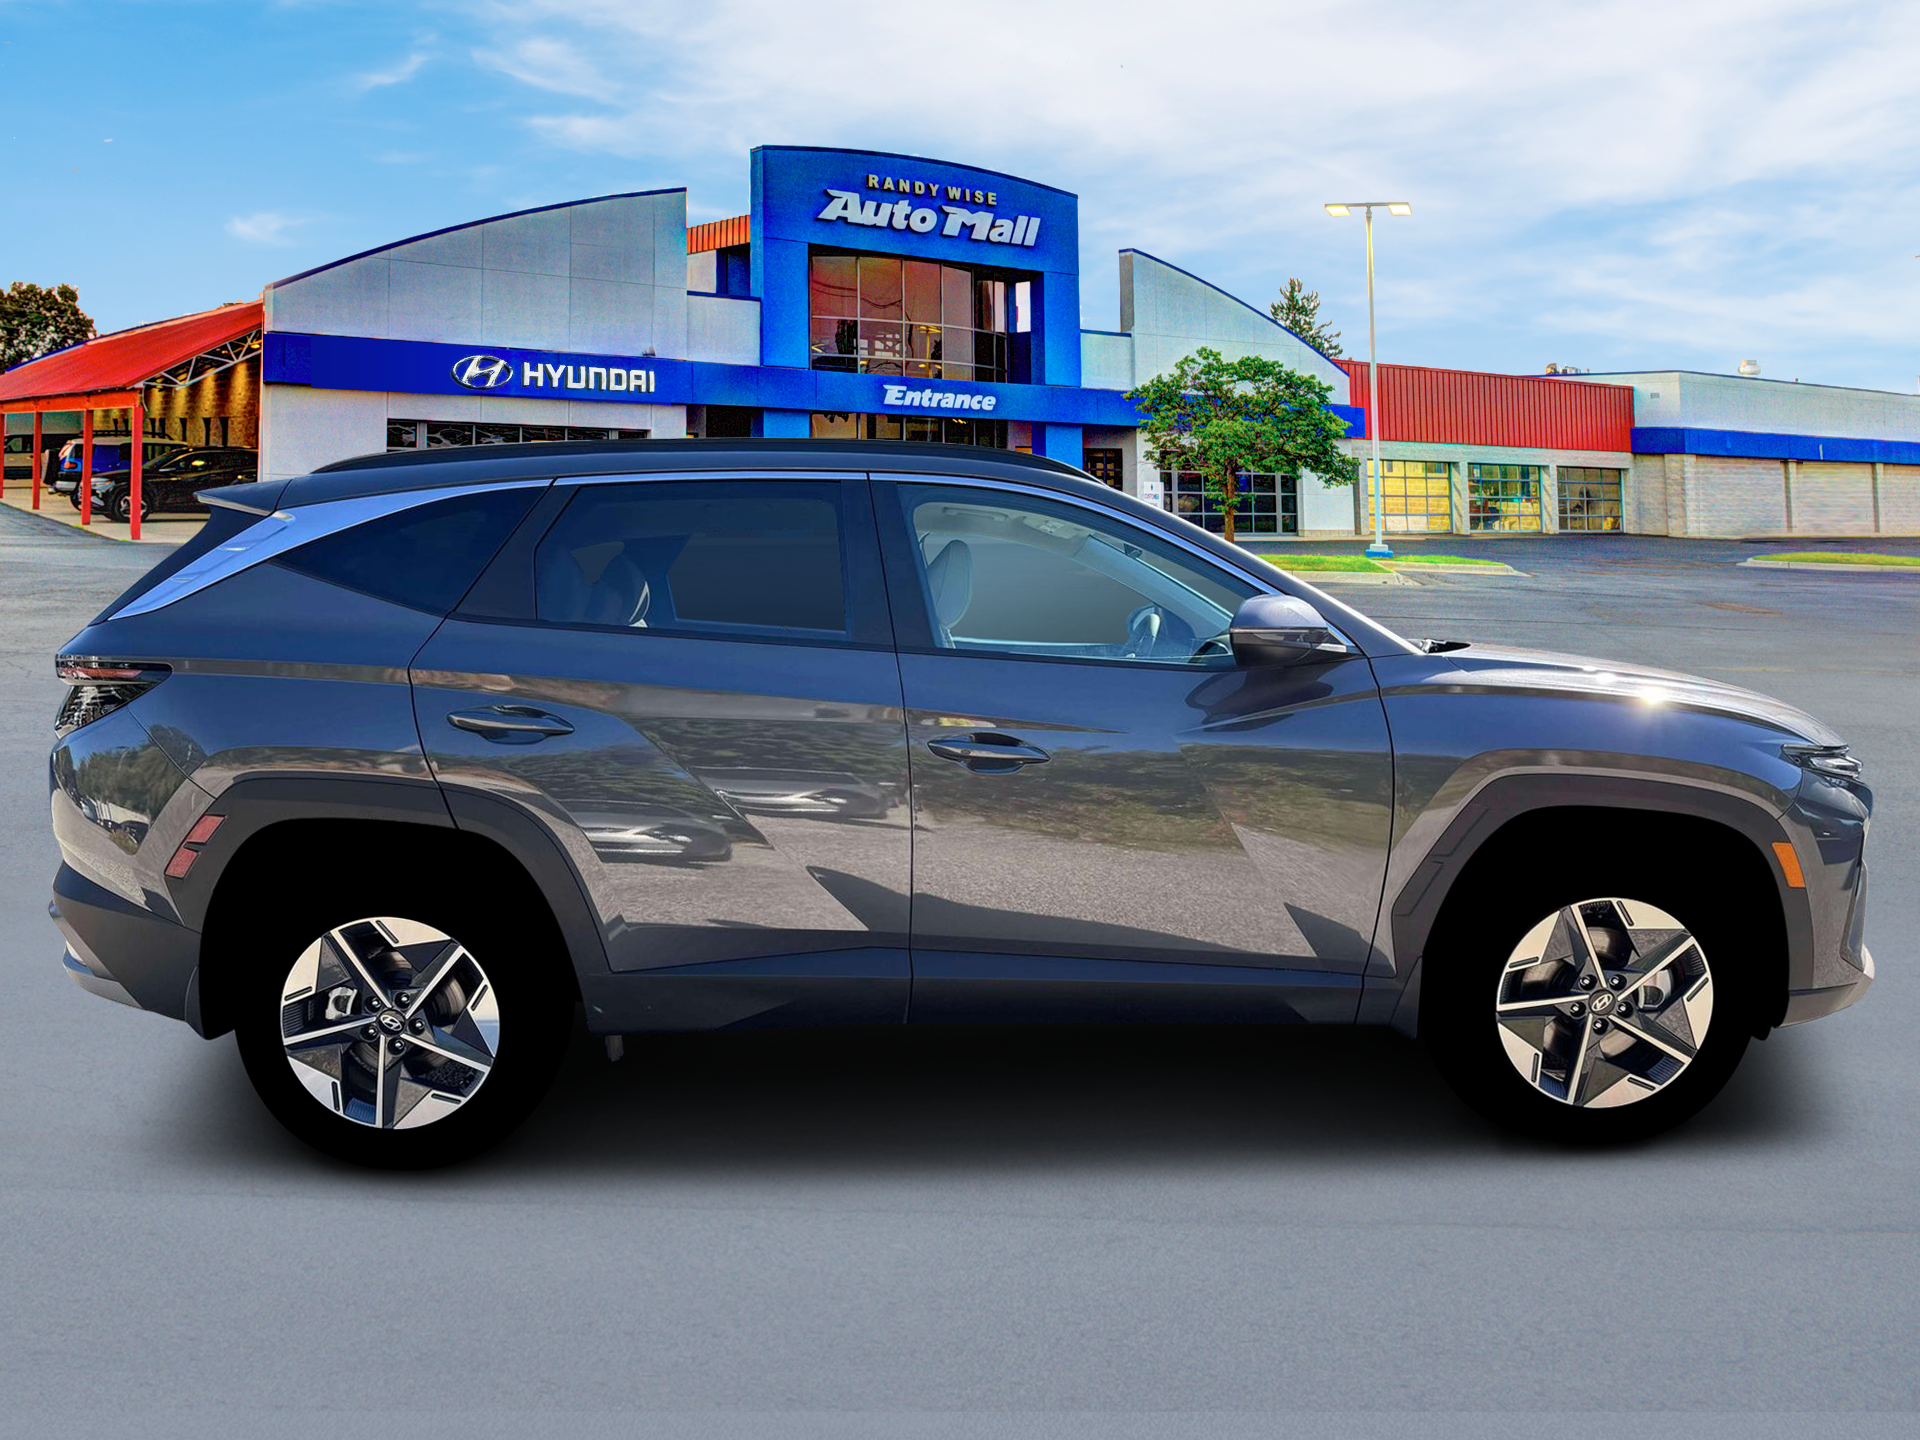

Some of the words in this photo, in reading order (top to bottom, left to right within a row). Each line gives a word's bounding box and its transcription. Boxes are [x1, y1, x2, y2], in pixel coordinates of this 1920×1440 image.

[867, 174, 939, 197] RANDY
[947, 185, 998, 206] WISE
[816, 188, 937, 233] Auto
[941, 205, 1041, 247] Mall
[522, 361, 656, 393] HYUNDAI
[882, 384, 996, 411] Entrance
